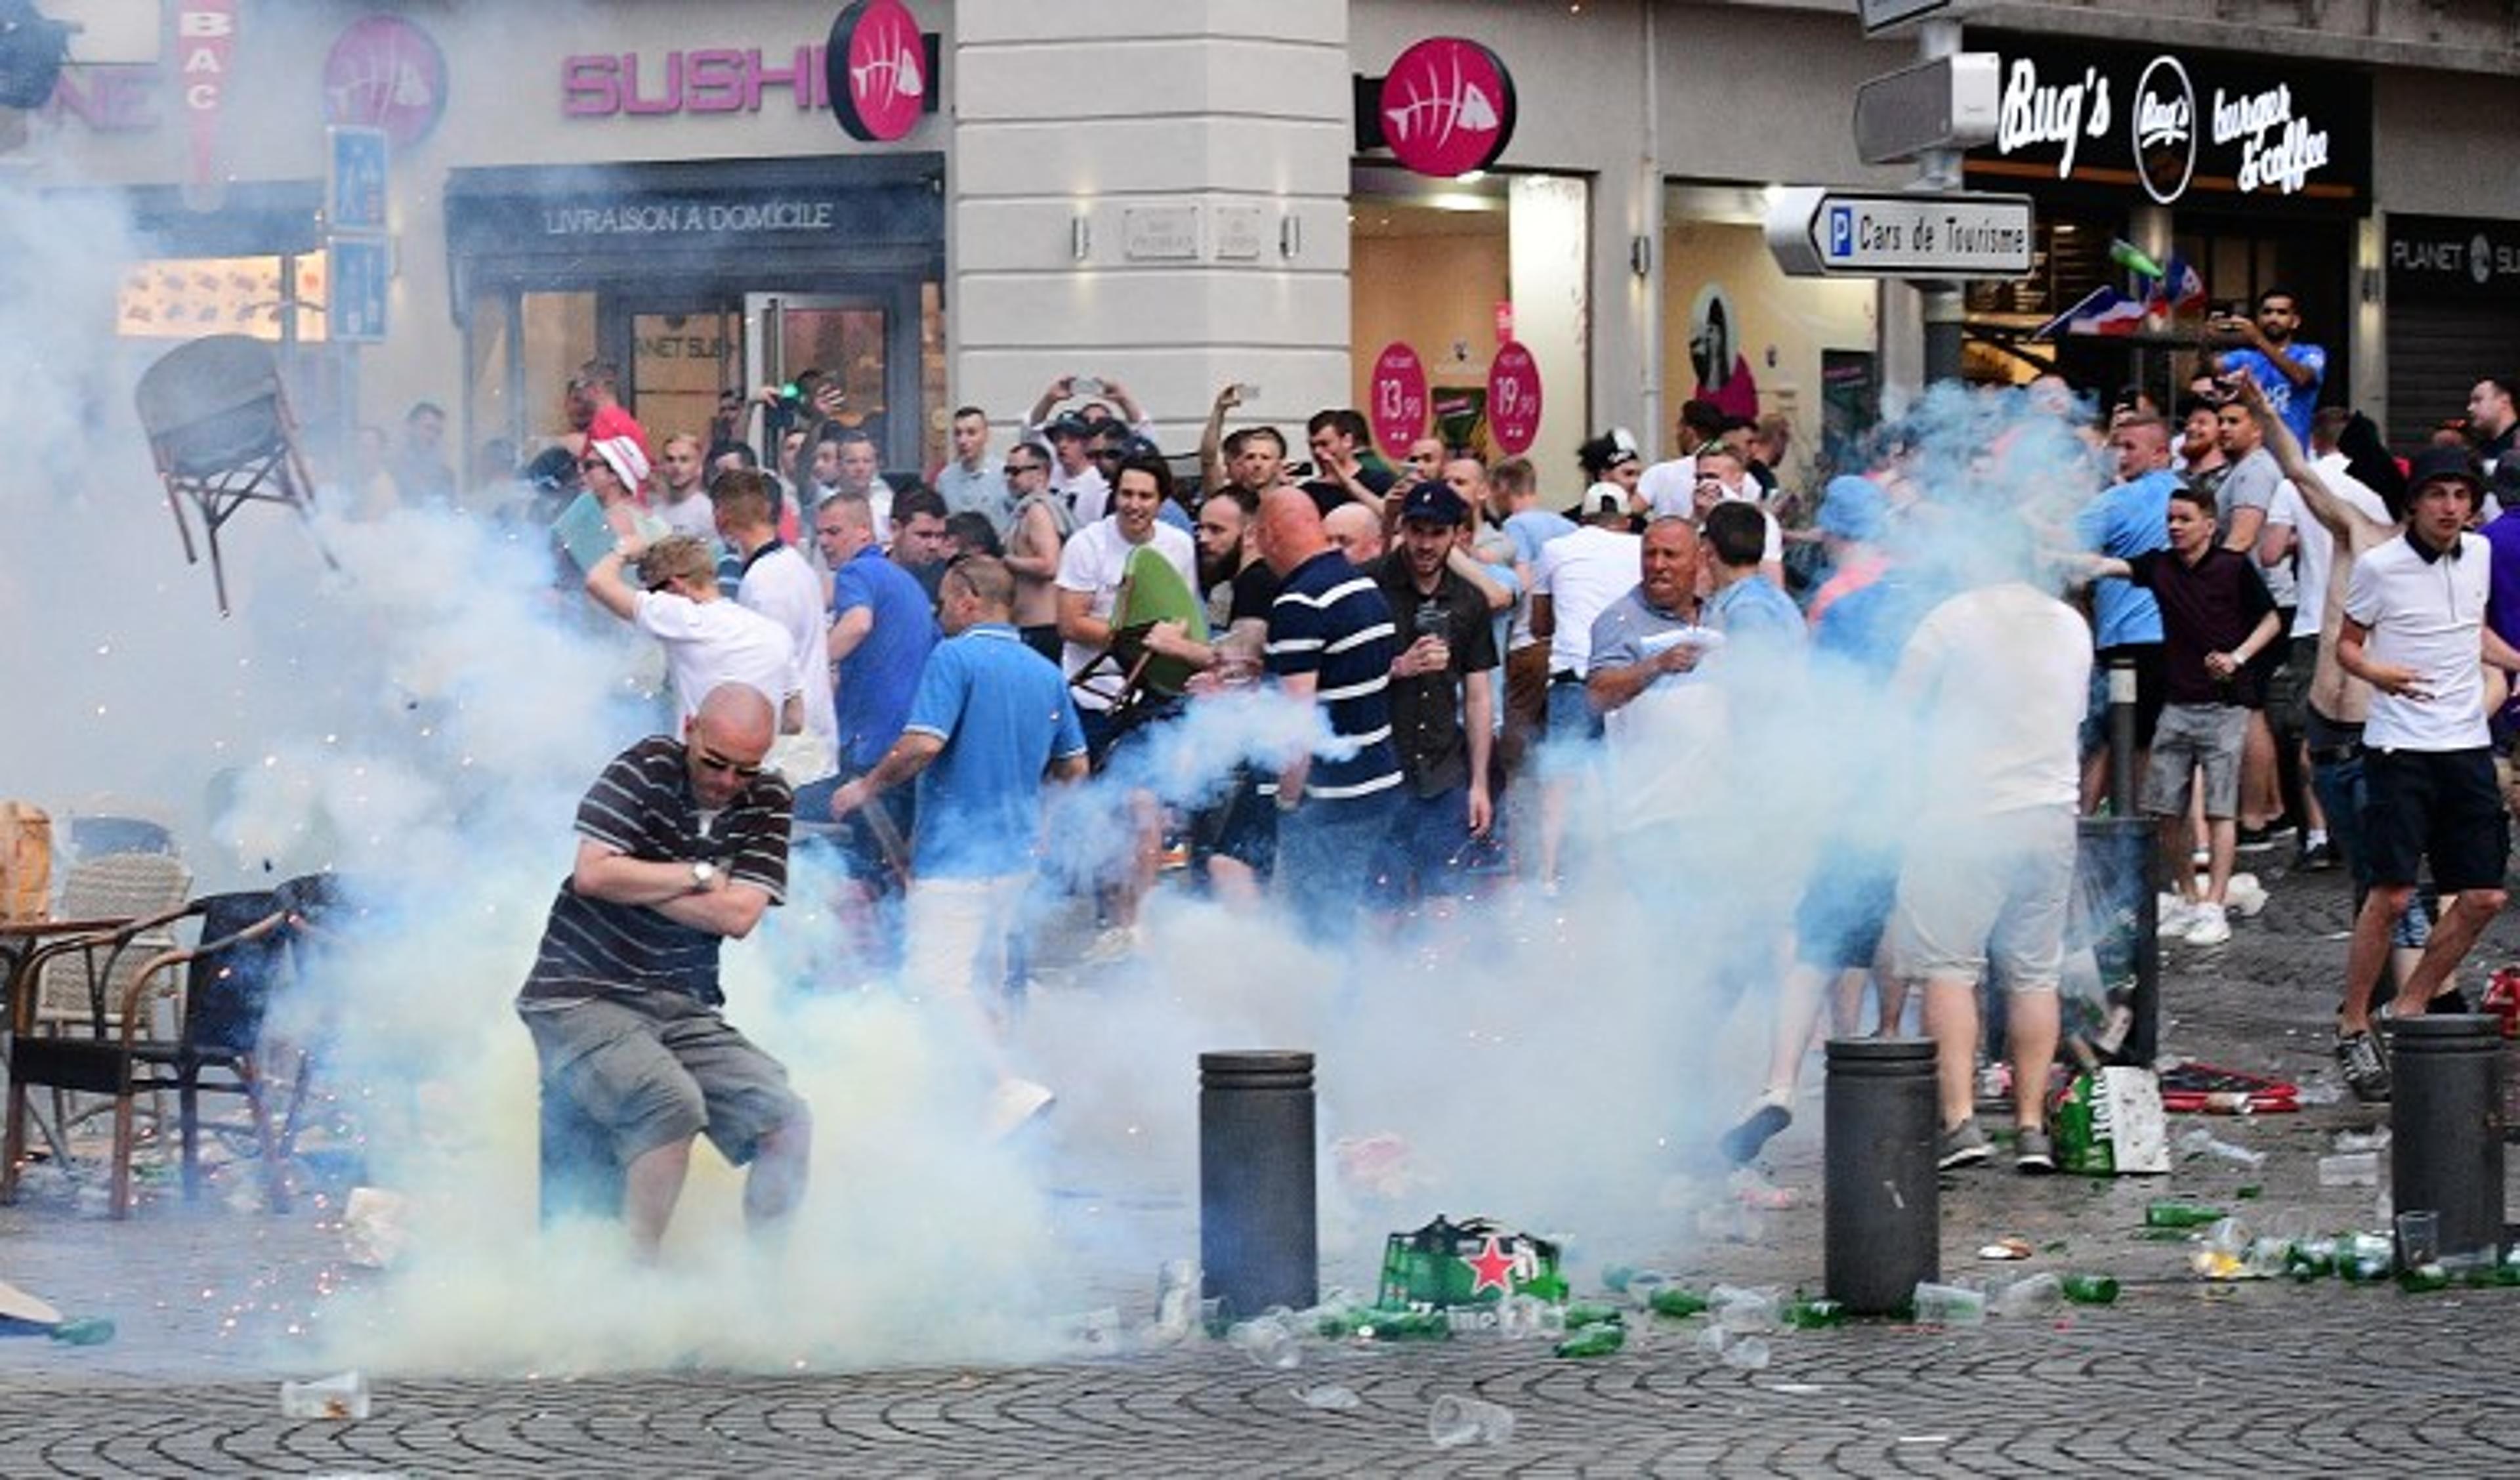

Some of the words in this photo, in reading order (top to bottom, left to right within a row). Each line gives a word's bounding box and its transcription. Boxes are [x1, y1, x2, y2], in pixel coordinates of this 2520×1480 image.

[564, 47, 828, 116] SUSHI
[1998, 58, 2110, 179] Bug's
[2140, 91, 2189, 146] Bug's
[2213, 82, 2290, 152] burger
[543, 205, 679, 234] LIVRAISON
[709, 201, 834, 230] DOMICILE
[1860, 215, 1901, 250] Cars
[1913, 217, 1934, 251] de
[1944, 217, 2025, 254] Tourisme
[2391, 240, 2463, 270] PLANET
